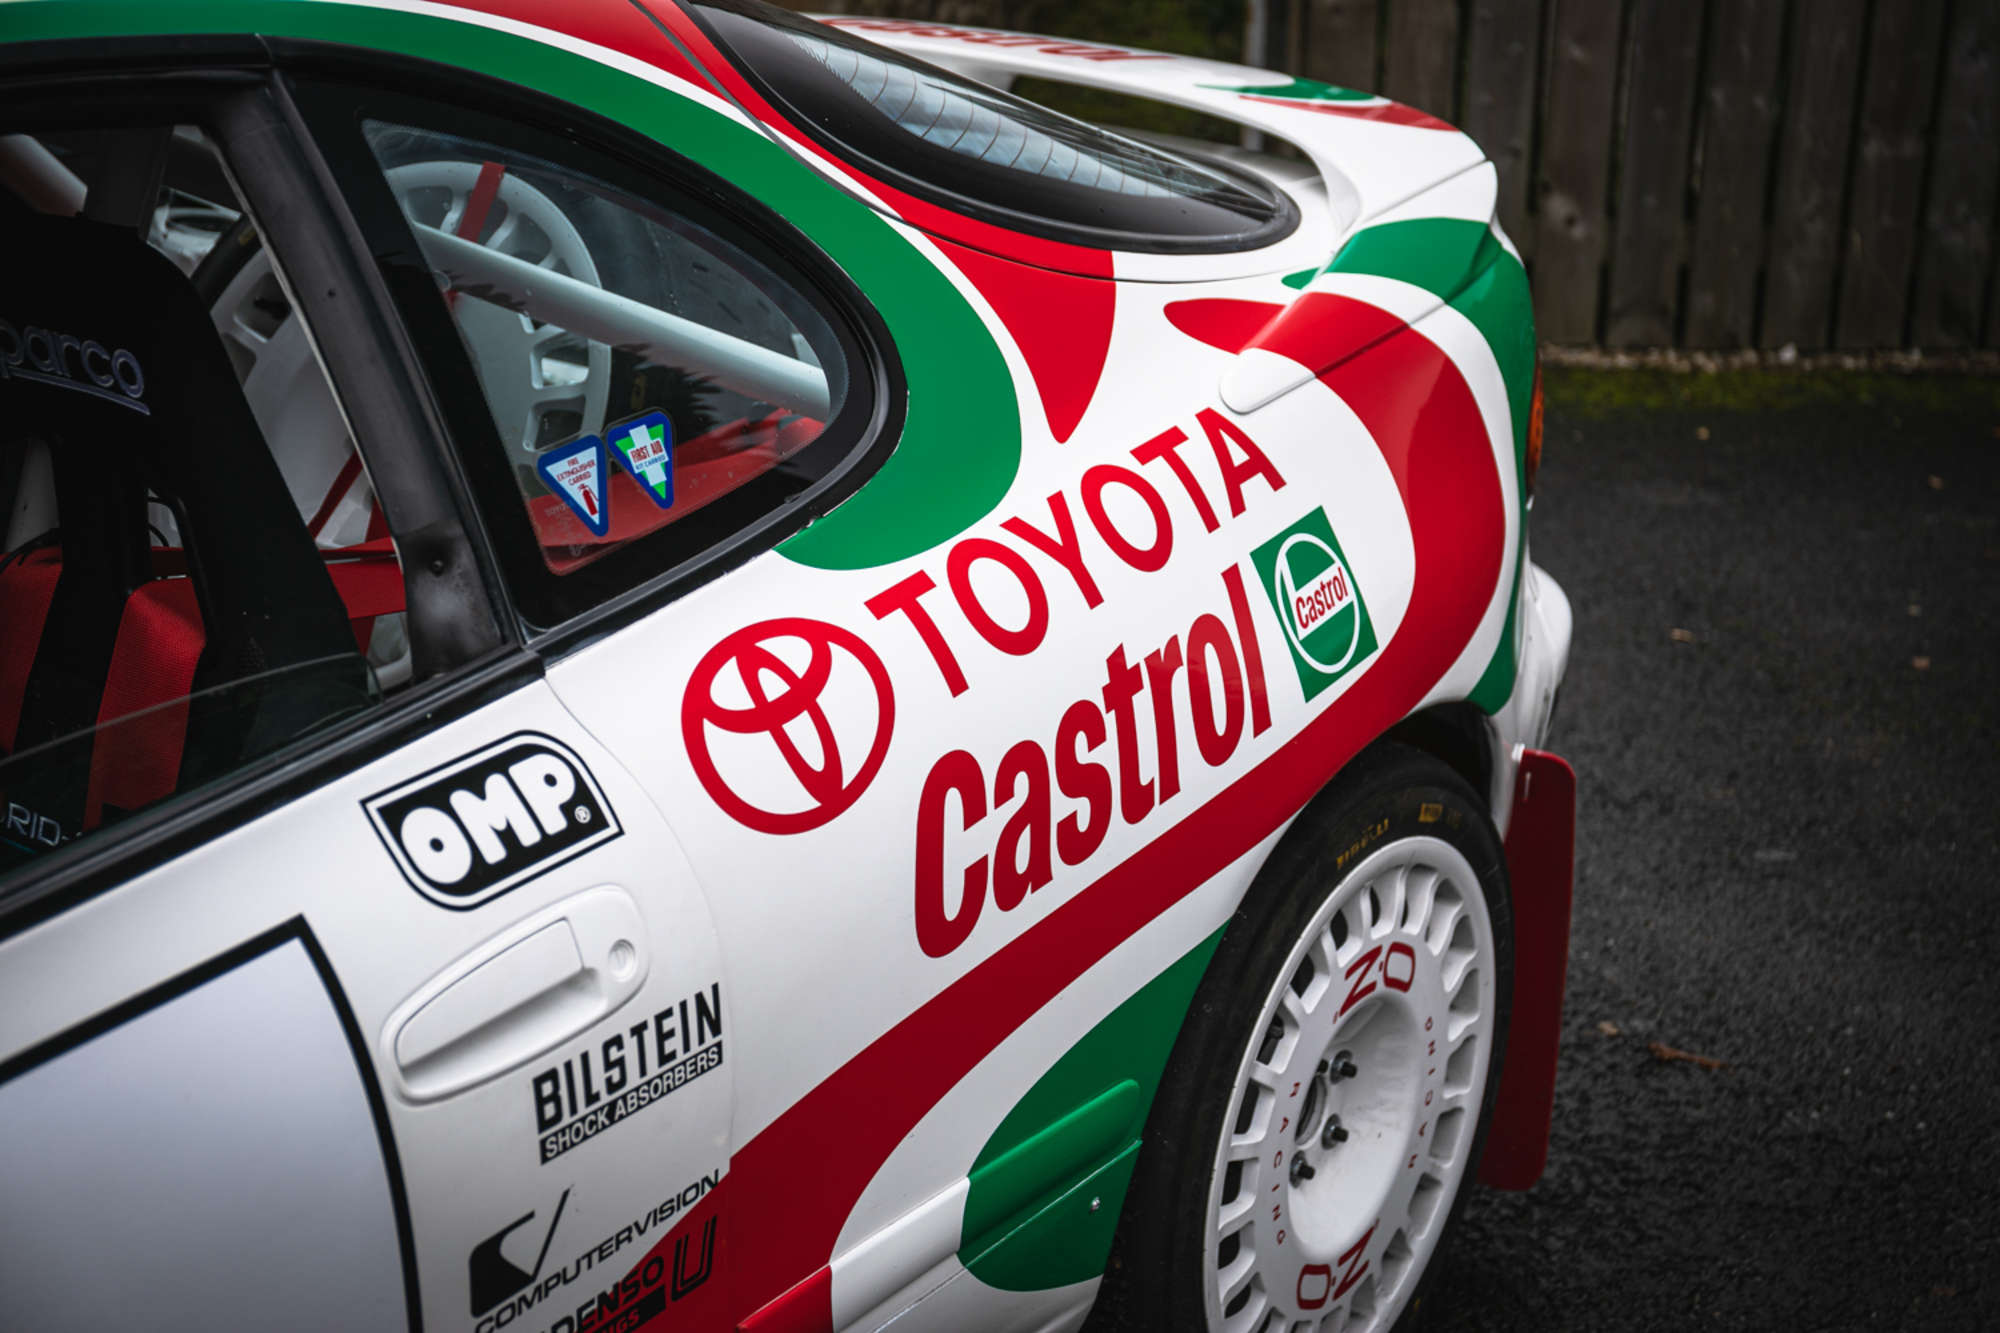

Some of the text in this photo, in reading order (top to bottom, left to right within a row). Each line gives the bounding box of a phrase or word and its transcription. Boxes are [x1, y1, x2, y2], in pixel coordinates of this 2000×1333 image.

[630, 440, 663, 464] FIRST AID
[864, 407, 1286, 698] TOYOTA
[1295, 566, 1349, 629] Castrol
[915, 563, 1272, 957] Castrol
[532, 982, 722, 1135] BILSTEIN
[545, 1046, 720, 1158] SHOCK ABSORBERS
[475, 1169, 719, 1333] COMPUTERVISION
